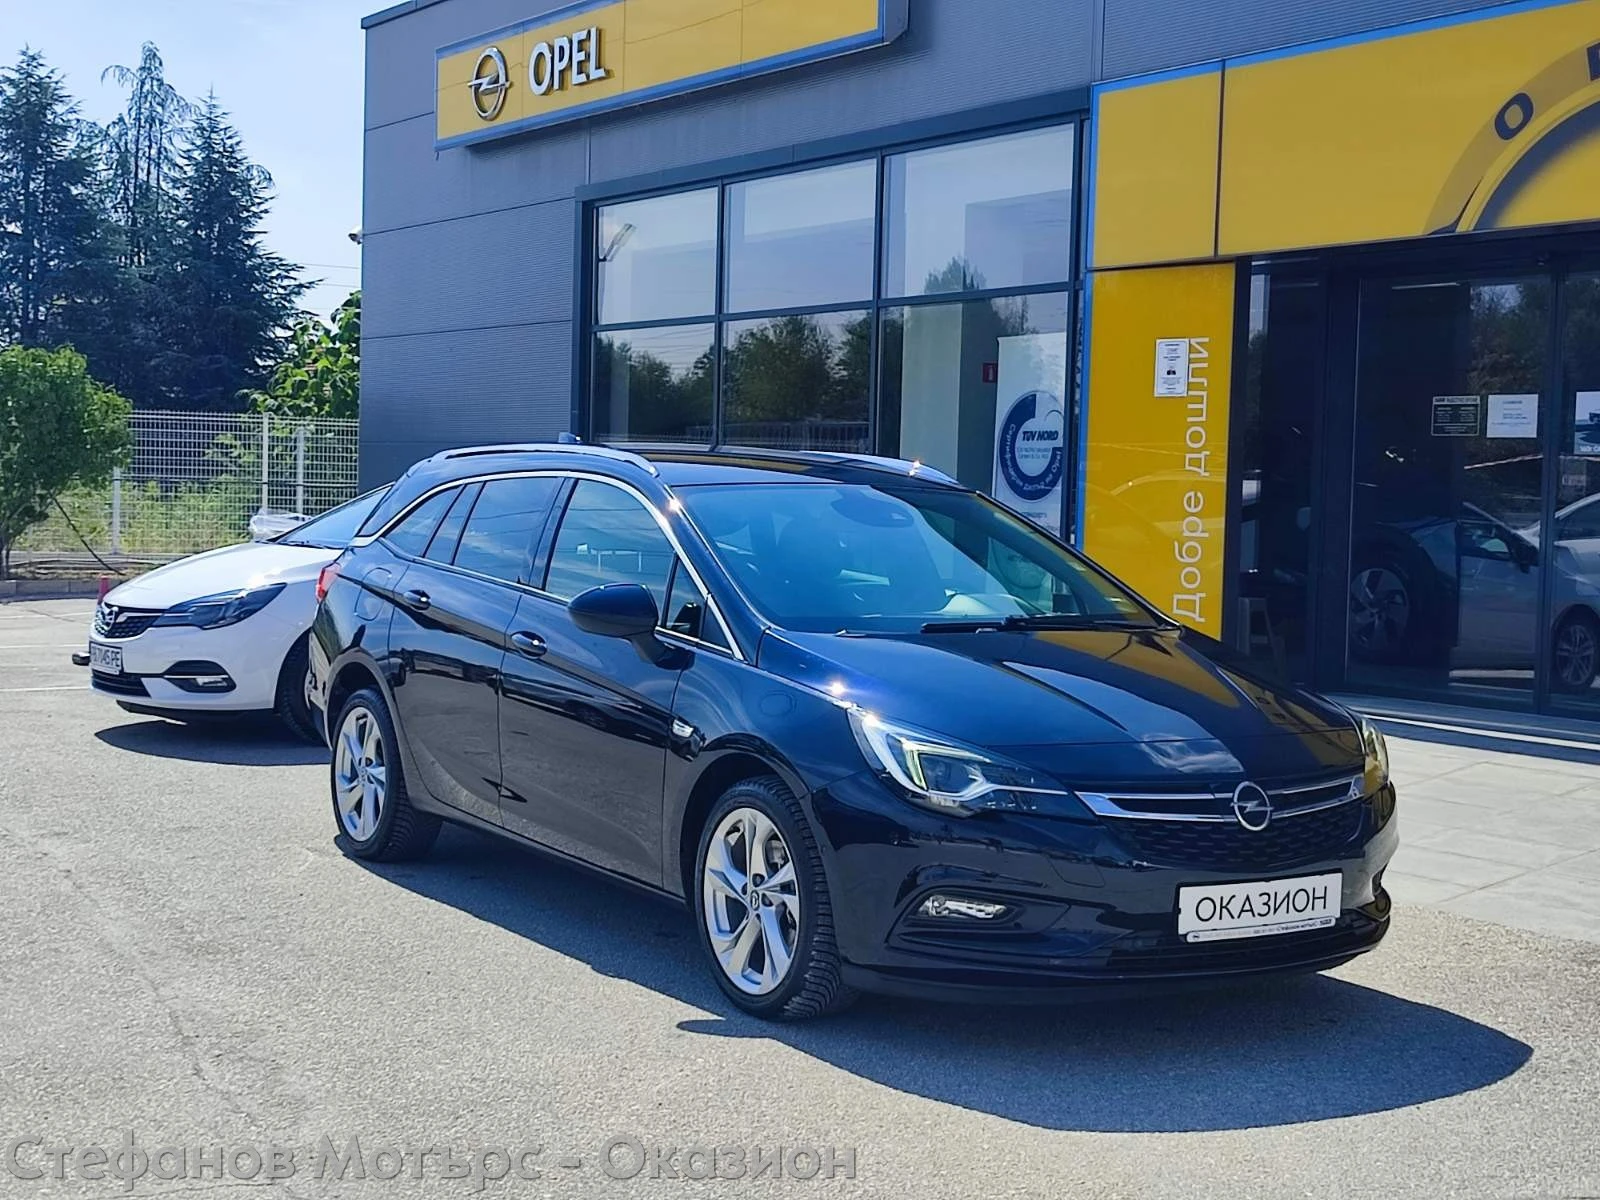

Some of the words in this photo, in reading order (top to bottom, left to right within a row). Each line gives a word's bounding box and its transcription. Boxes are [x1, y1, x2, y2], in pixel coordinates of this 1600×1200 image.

[528, 26, 606, 96] OPEL
[1037, 430, 1059, 442] NORD
[1184, 337, 1210, 477] дошли
[1172, 490, 1209, 623] Добре
[1195, 886, 1328, 922] ОКАЗИОН
